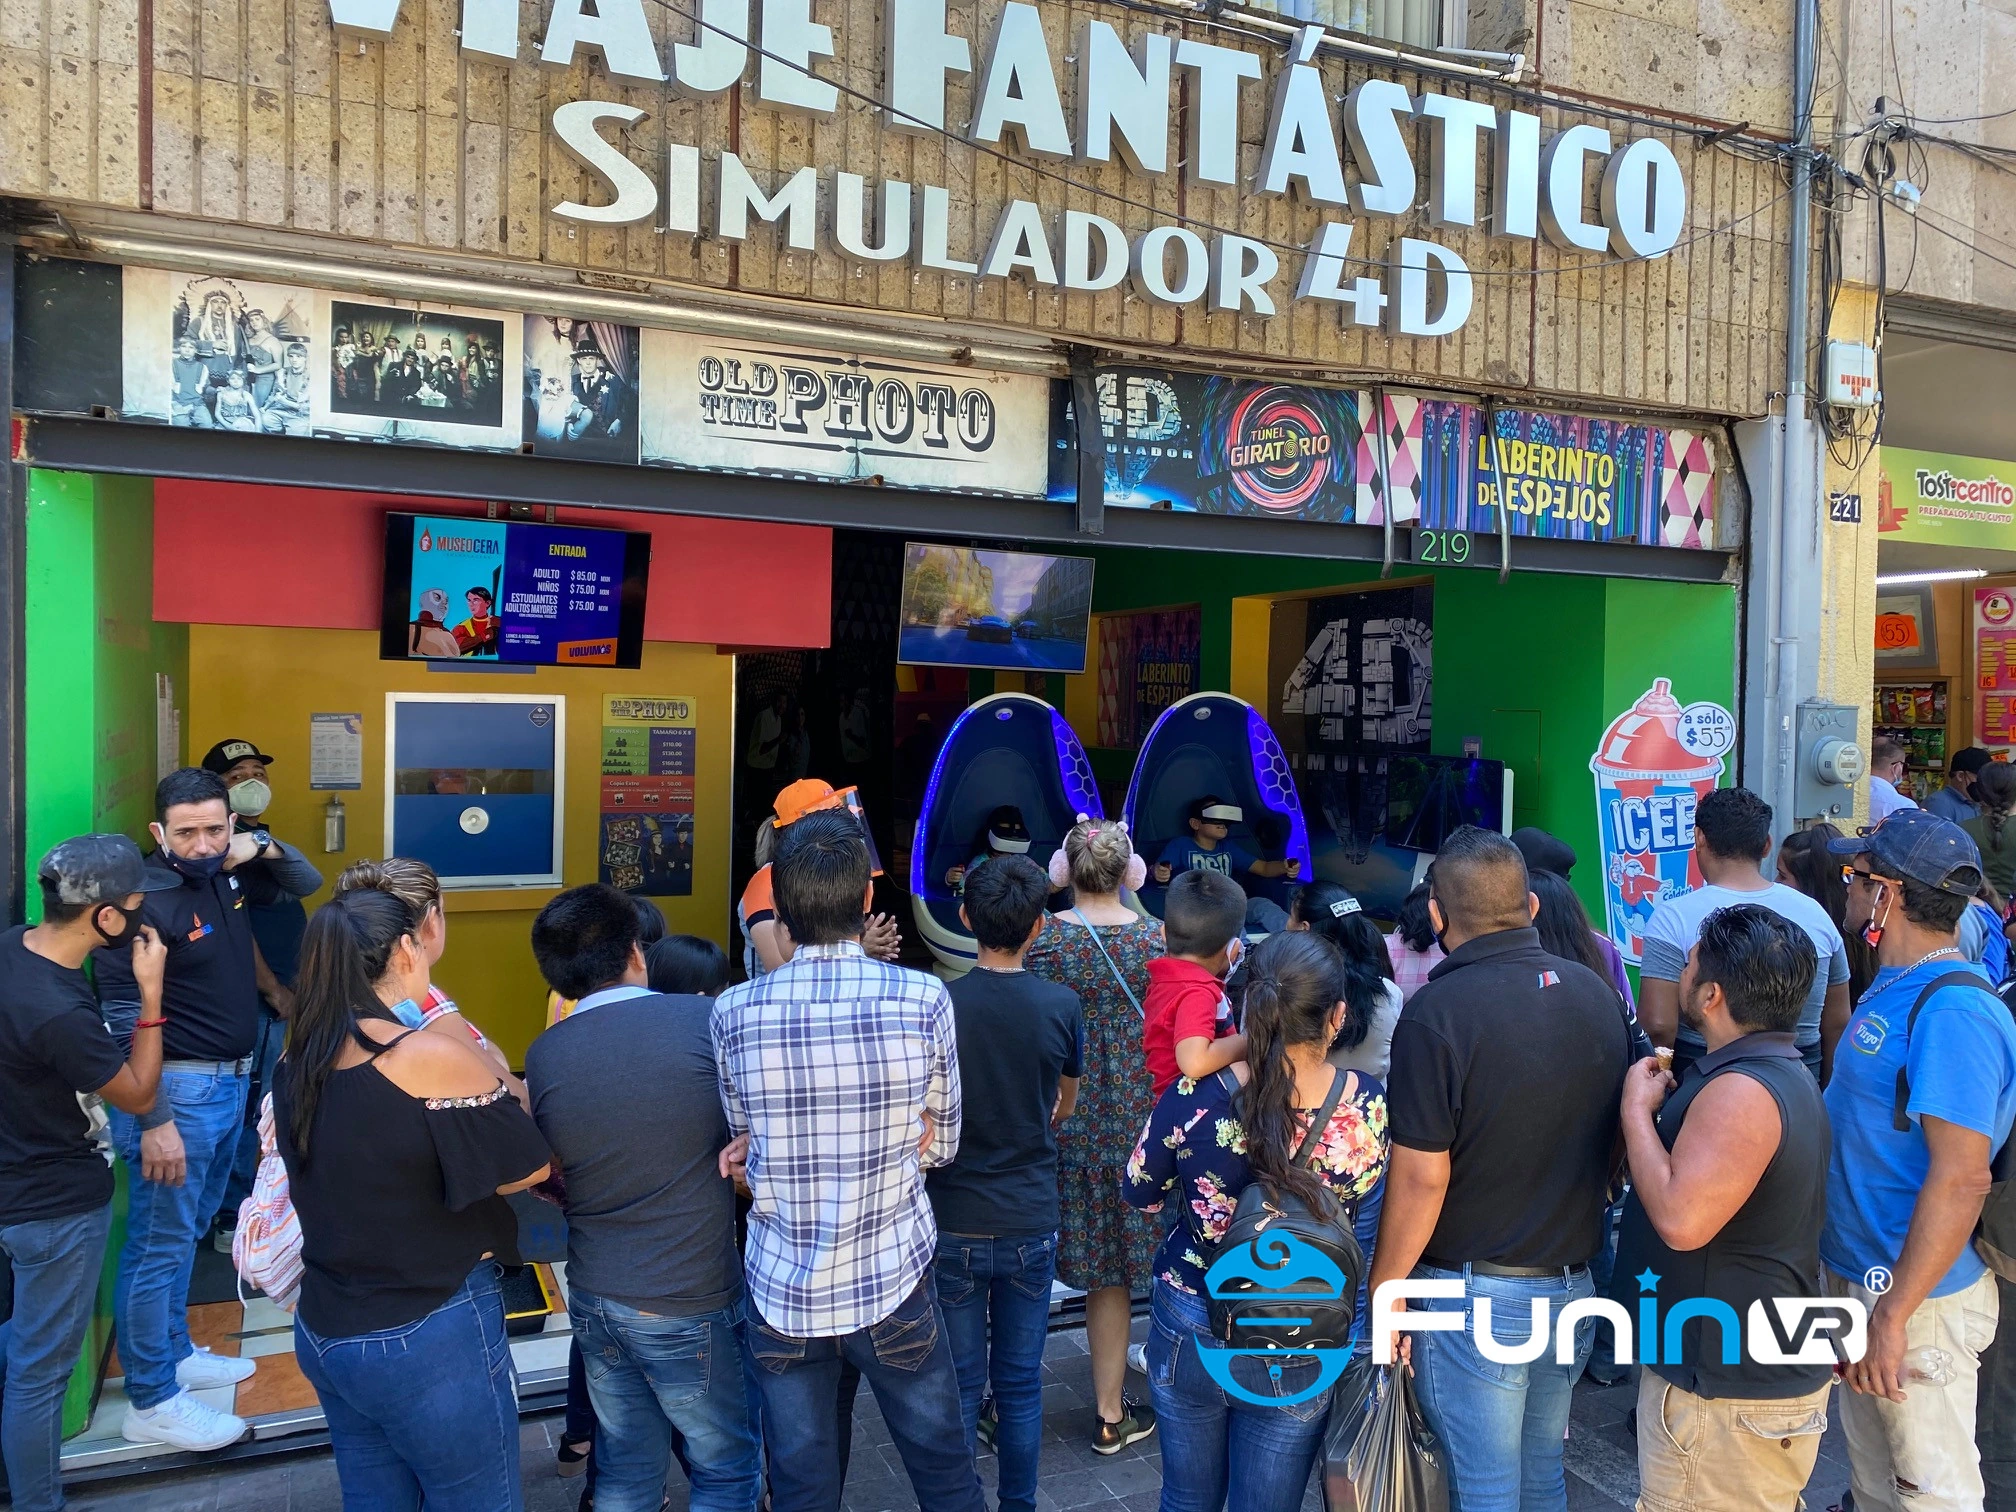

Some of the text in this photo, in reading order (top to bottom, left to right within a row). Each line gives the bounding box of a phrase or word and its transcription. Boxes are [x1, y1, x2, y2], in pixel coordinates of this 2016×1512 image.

[330, 0, 1686, 260] AJE FANTÁSTICO
[550, 100, 1474, 337] SIMULADOR 4D
[699, 356, 777, 395] OLD
[699, 392, 778, 431] TIME
[779, 365, 995, 452] PHOTO
[1250, 426, 1286, 442] TÚNEL
[1056, 438, 1193, 460] SIULADOR
[1229, 434, 1331, 468] GIRATORIO
[1477, 434, 1615, 489] LABERINTO
[1477, 482, 1499, 507] DE
[1505, 476, 1612, 527] ESPEJOS
[1832, 498, 1861, 520] 221
[1976, 512, 1986, 521] TU
[1987, 512, 2013, 524] GUSTO
[436, 536, 500, 555] MUSEOCERA
[548, 544, 587, 558] ENTRADA
[1419, 530, 1471, 564] 219
[533, 568, 560, 579] ADULTO
[537, 581, 560, 593] NIÑOS
[504, 603, 558, 615] ADULTOS MAYORES
[511, 593, 558, 605] ESTUDIANTES
[1884, 623, 1906, 643] 55
[569, 644, 612, 658] VOLVIMOS
[1137, 662, 1191, 685] LABERINTO
[1137, 684, 1190, 706] DE ESPEJOS
[631, 701, 689, 719] PHOTO
[1684, 709, 1724, 724] a sólo
[228, 744, 247, 753] FOX
[1856, 1023, 1880, 1045] Virgo
